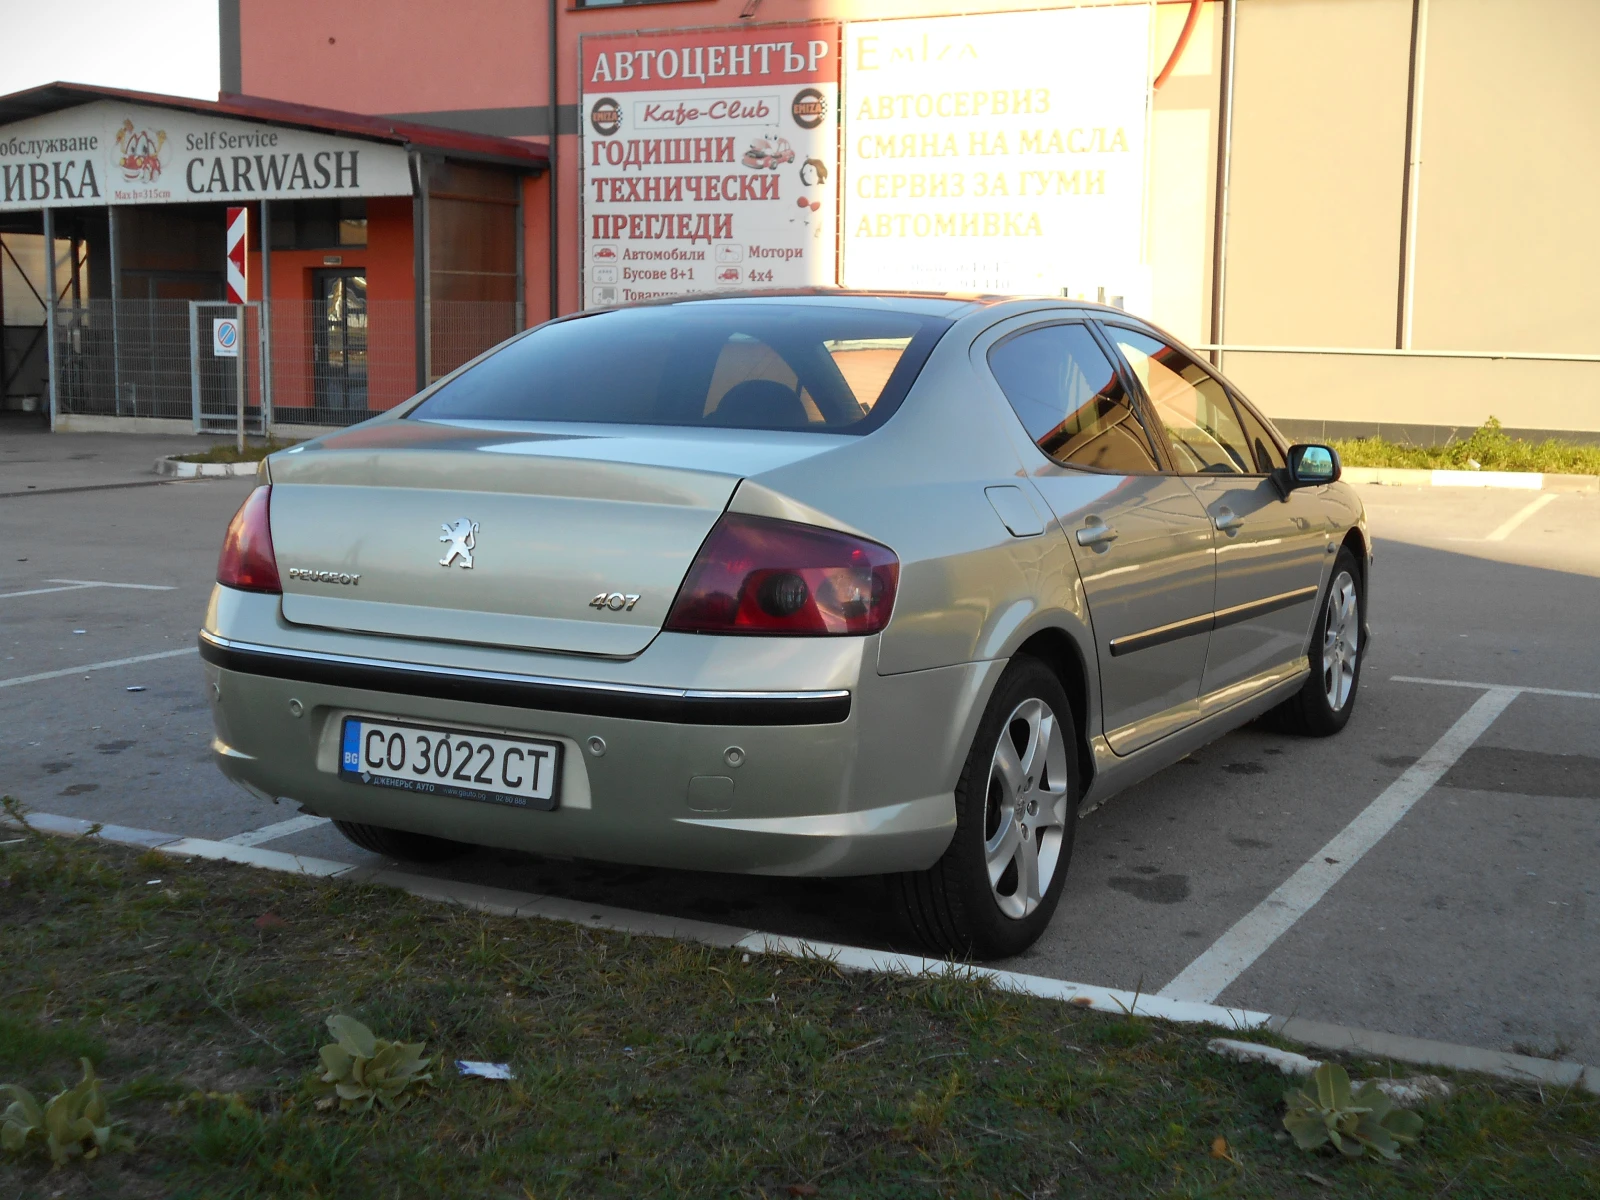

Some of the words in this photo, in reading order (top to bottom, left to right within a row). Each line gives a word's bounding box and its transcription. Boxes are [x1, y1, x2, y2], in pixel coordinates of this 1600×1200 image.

[590, 40, 829, 84] АВТОЦЕНТЪР
[643, 100, 770, 125] Kafe-Club
[794, 102, 822, 114] EMIZA
[856, 87, 1051, 120] АВТОСЕРВИЗ
[186, 131, 217, 151] Self
[219, 130, 278, 149] Service
[856, 132, 959, 160] СМЯНА
[968, 129, 1009, 157] НА
[1018, 126, 1130, 156] МАСЛА
[591, 136, 736, 172] ГОДИШНИ
[2, 160, 101, 202] ИВКА
[186, 150, 360, 194] CARWASH
[114, 191, 131, 200] Max
[132, 189, 171, 199] h=315cm
[591, 173, 780, 203] ТЕХНИЧЕСКИ
[856, 172, 965, 199] СЕРВИЗ
[973, 171, 1010, 197] ЗА
[1018, 169, 1107, 197] ГУМИ
[591, 213, 733, 245] ПРЕГЛЕДИ
[855, 210, 1043, 238] АВТОМИВКА
[622, 248, 705, 260] Автомобили
[748, 246, 803, 261] Мотори
[622, 267, 667, 283] Бусове
[670, 267, 695, 280] 8+1
[748, 269, 773, 282] 4x4
[622, 288, 678, 300] Това
[289, 567, 361, 586] PEUGEOT
[588, 592, 641, 612] 407
[344, 752, 358, 765] BG
[415, 783, 435, 793] АУТО
